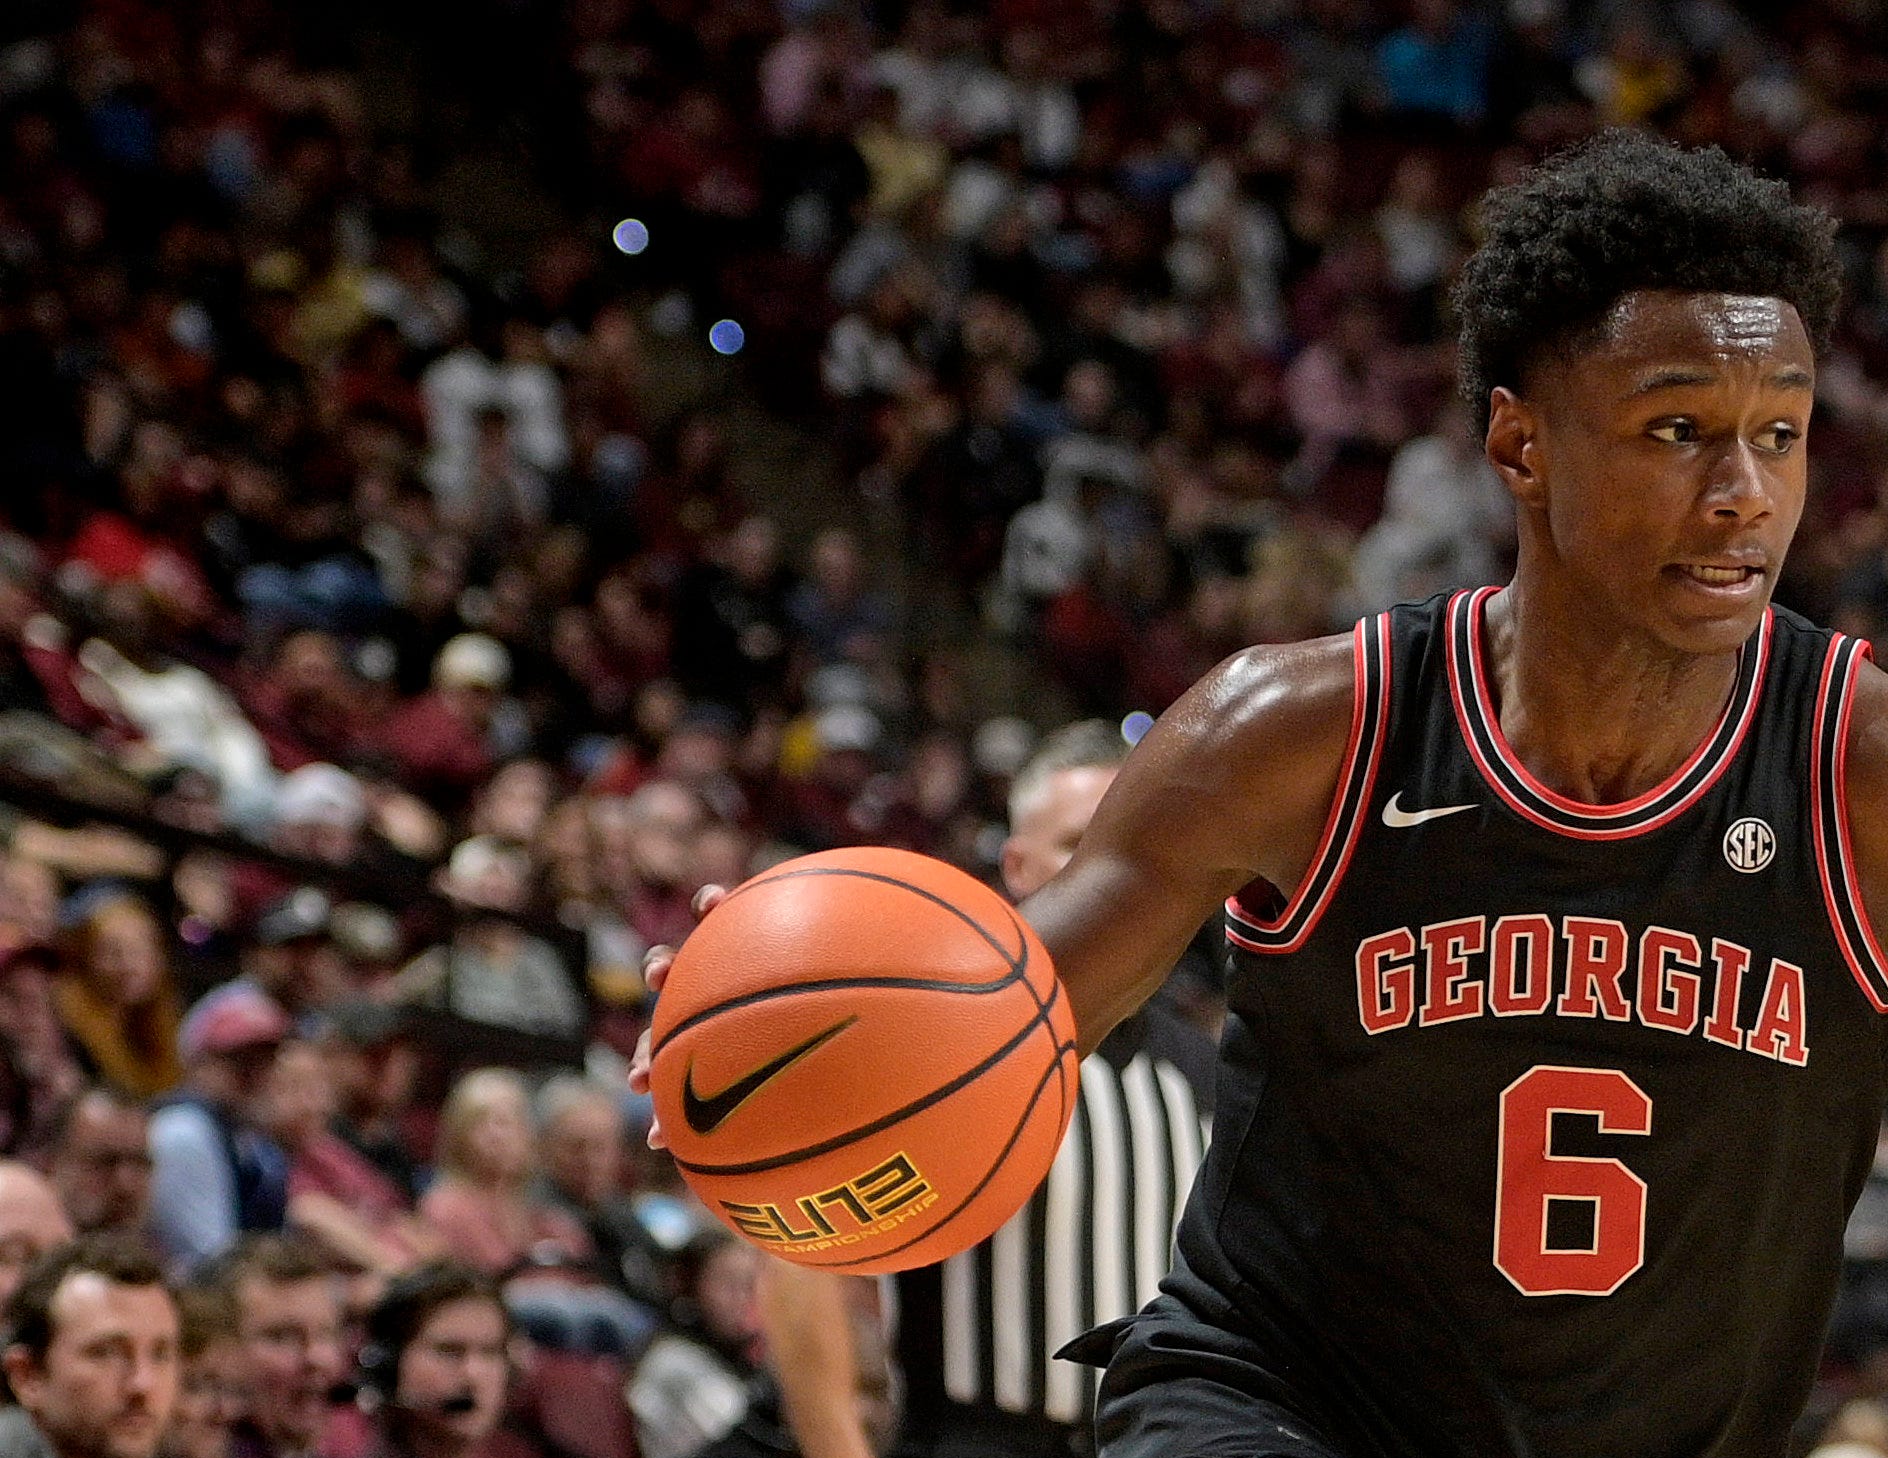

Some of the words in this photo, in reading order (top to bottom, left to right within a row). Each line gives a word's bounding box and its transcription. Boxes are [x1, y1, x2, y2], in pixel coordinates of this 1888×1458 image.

[1728, 822, 1772, 868] SEC
[1355, 913, 1809, 1067] GEORGIA
[718, 1150, 932, 1243] ELITE
[766, 1192, 939, 1254] AMPIONSHIP
[1493, 1064, 1653, 1297] 6
